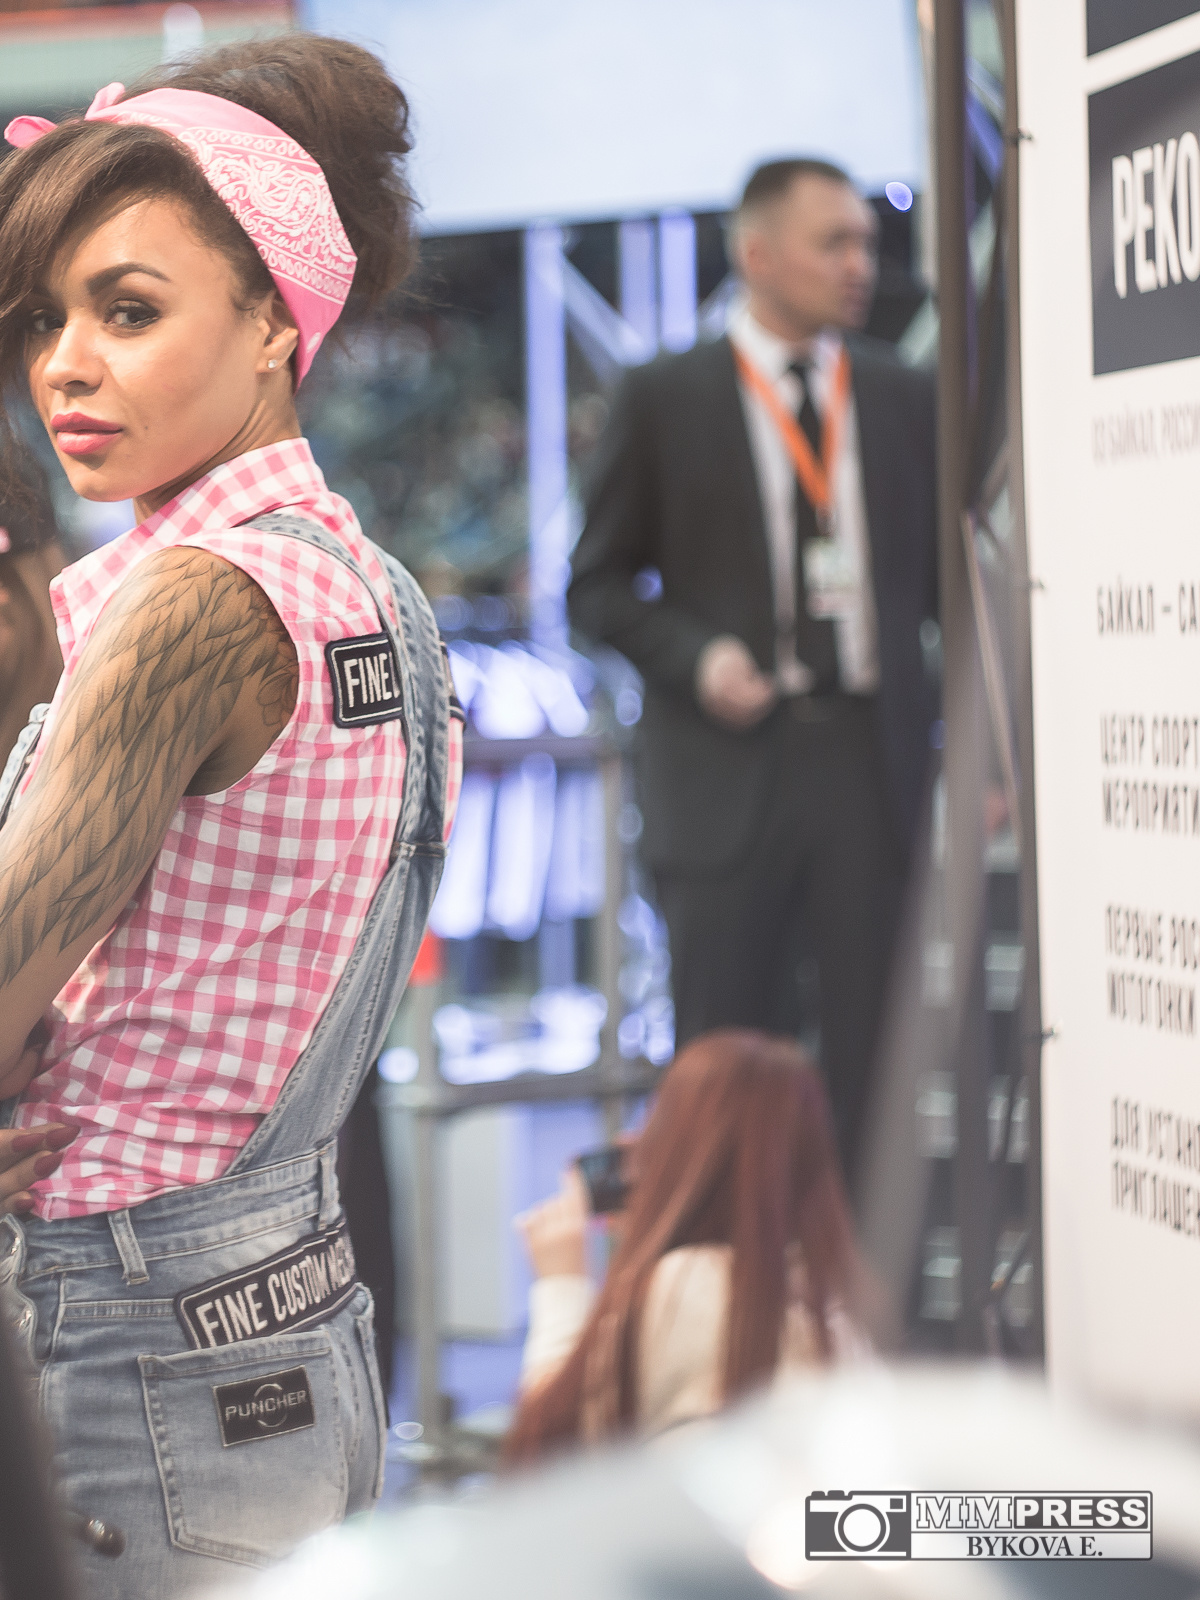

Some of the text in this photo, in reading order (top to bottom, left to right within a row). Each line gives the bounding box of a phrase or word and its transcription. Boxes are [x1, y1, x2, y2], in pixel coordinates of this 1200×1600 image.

[1112, 131, 1200, 299] РЕКО
[1097, 575, 1155, 636] БАЙКАЛ
[1178, 583, 1200, 636] СА
[343, 653, 392, 708] FINE
[1101, 714, 1200, 769] ЦЕНТР СПОРТ
[1105, 903, 1164, 964] ПЕРВЫЕ
[1106, 969, 1196, 1036] МОТОГОНКИ
[1111, 1096, 1142, 1154] ДЛЯ
[196, 1283, 268, 1348] FINE
[267, 1252, 331, 1322] CUSTOM
[225, 1389, 306, 1422] PUNCHER
